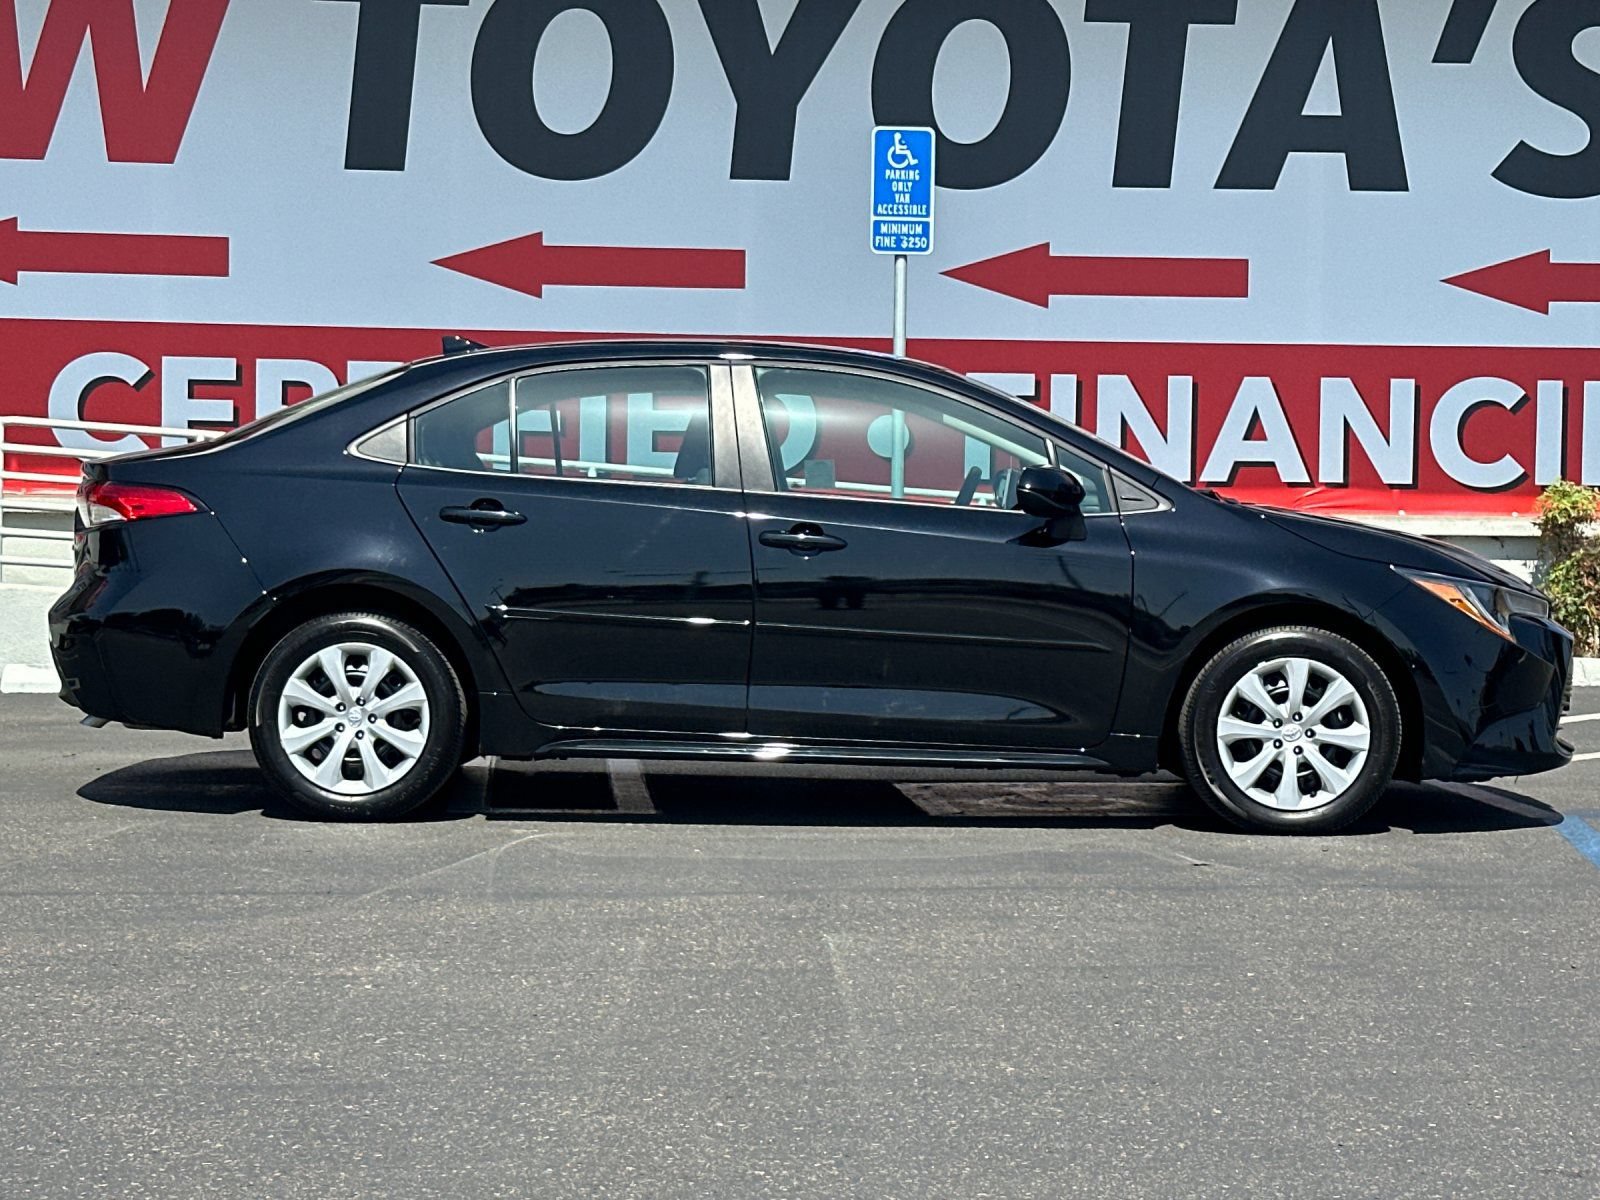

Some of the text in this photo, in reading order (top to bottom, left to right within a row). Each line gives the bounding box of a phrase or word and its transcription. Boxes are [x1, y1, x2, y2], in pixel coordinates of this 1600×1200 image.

[316, 0, 1600, 199] TOYOTA'S
[885, 169, 920, 181] PARKING
[891, 181, 913, 192] ONLY
[895, 193, 911, 204] VAN
[877, 204, 927, 215] ACCESSIBLE
[880, 222, 923, 235] MINIMUM
[875, 235, 928, 249] FINE $250
